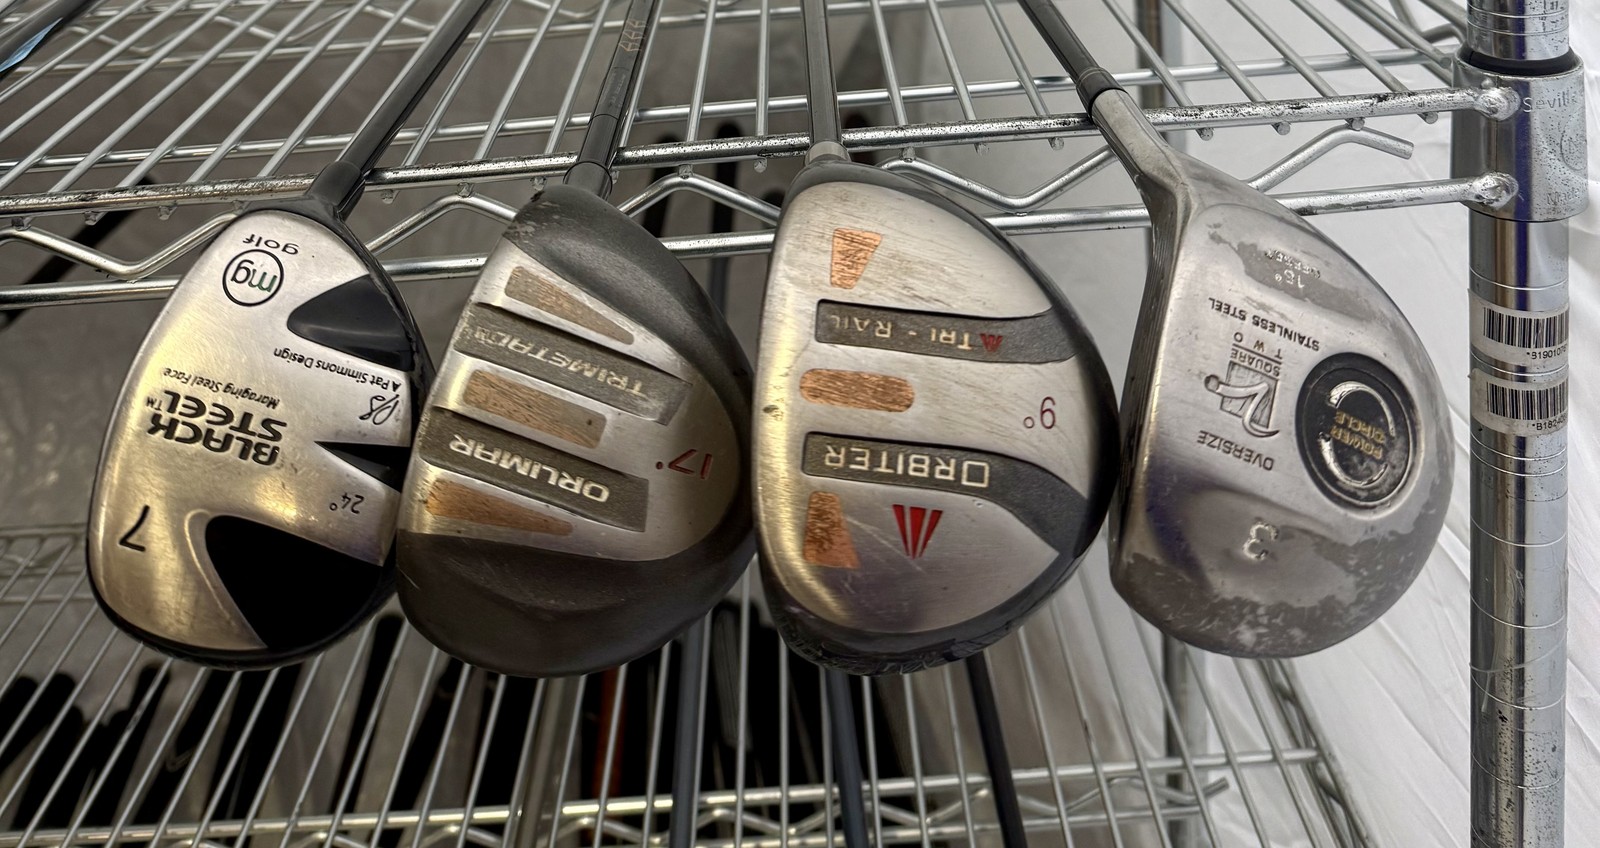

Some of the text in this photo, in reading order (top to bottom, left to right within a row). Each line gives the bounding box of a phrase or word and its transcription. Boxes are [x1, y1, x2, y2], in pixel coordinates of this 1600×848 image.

[243, 233, 299, 255] golf
[231, 259, 277, 293] mg
[830, 314, 892, 338] RAIL
[931, 327, 972, 350] TRI
[1208, 297, 1320, 352] STAINLESS STEEL
[273, 347, 401, 392] A Pat Simmons Design
[1230, 348, 1281, 378] SQUARE
[163, 367, 280, 410] Maraging Steel Face
[1023, 396, 1057, 430] 9°
[1334, 410, 1387, 444] CIRCLE
[147, 412, 280, 466] BLACK
[1196, 430, 1275, 471] OVERSIZE
[1329, 426, 1383, 460] POWER
[449, 434, 611, 503] ORLIMAR
[824, 445, 990, 488] ORBITER
[329, 492, 365, 514] 24°
[118, 504, 150, 552] 7
[1242, 518, 1278, 560] 3
